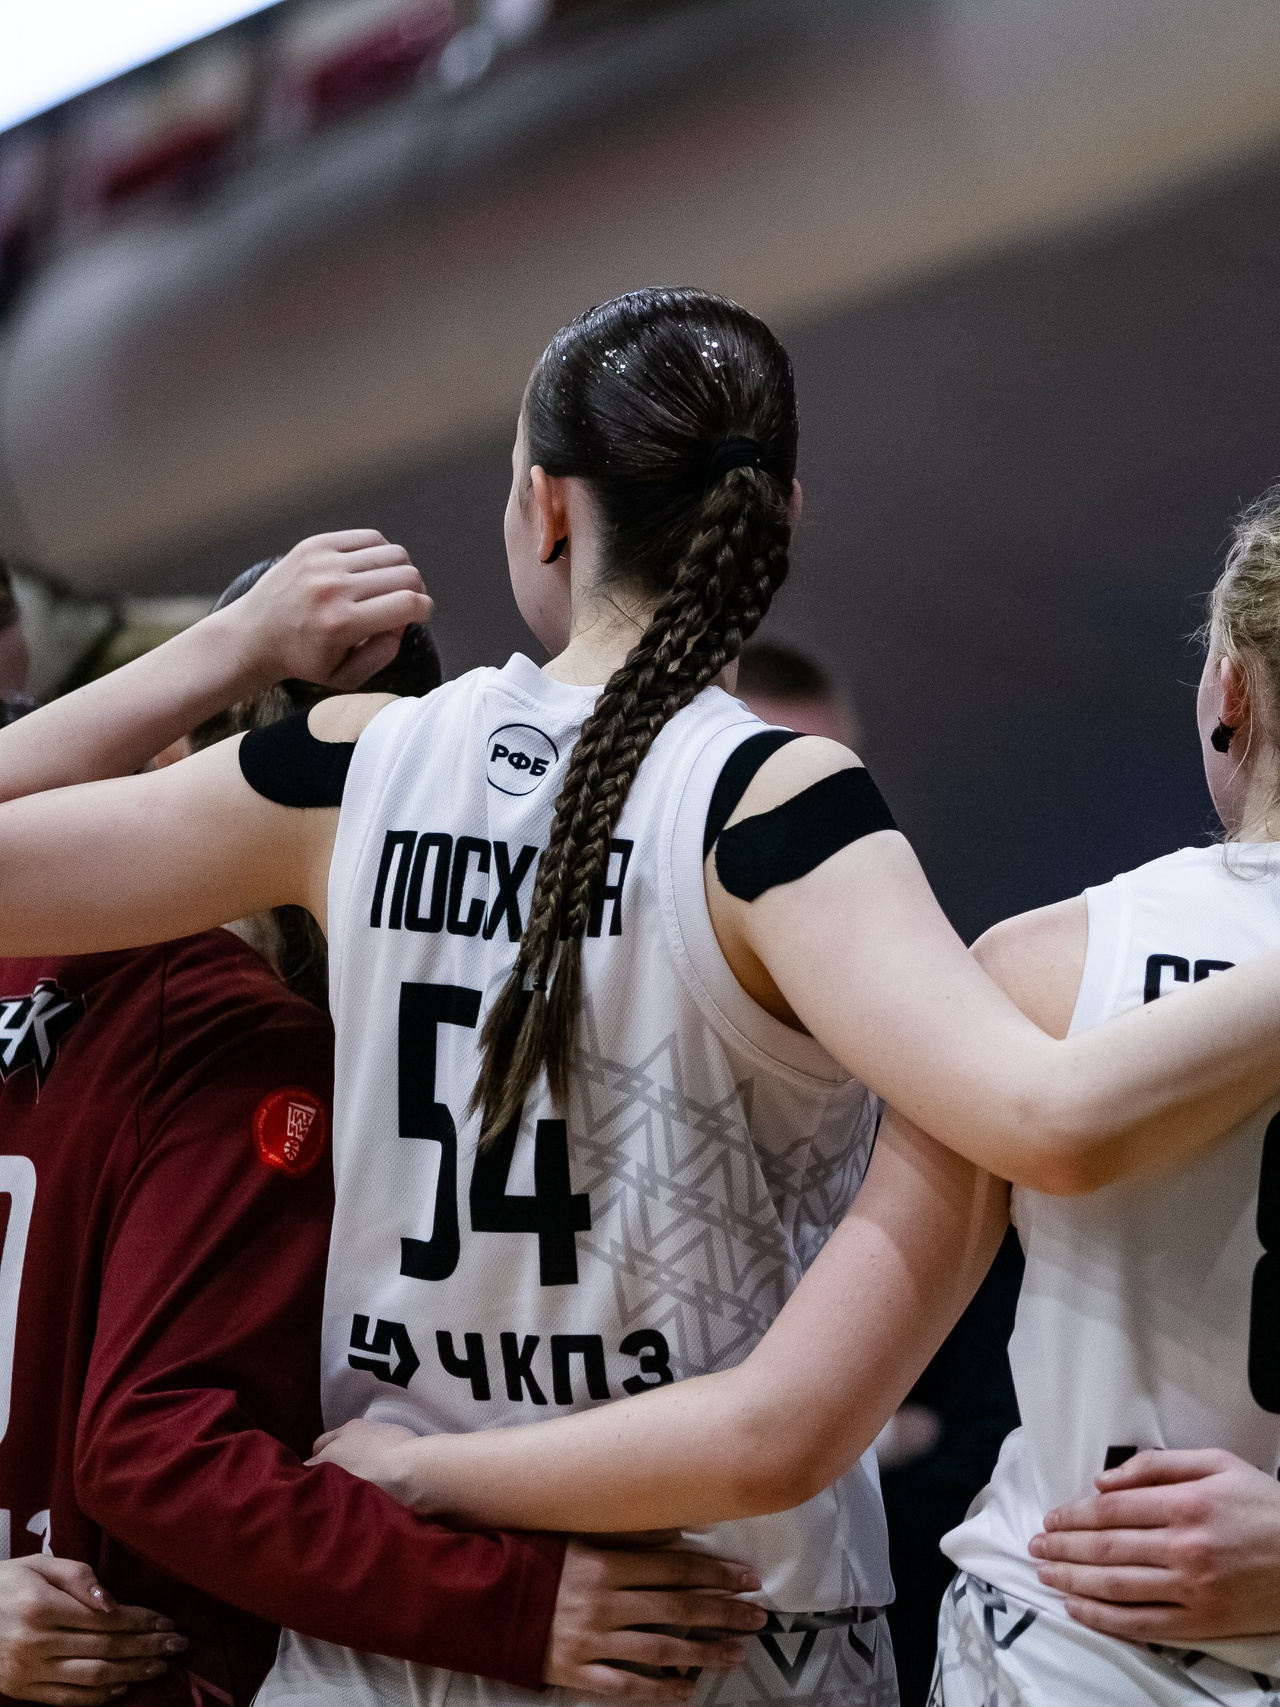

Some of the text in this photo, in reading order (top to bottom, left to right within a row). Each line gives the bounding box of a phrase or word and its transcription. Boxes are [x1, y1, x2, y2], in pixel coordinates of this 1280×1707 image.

[490, 743, 550, 778] РФБ
[399, 981, 592, 1288] 54
[435, 1327, 675, 1406] ЧКПЗ
